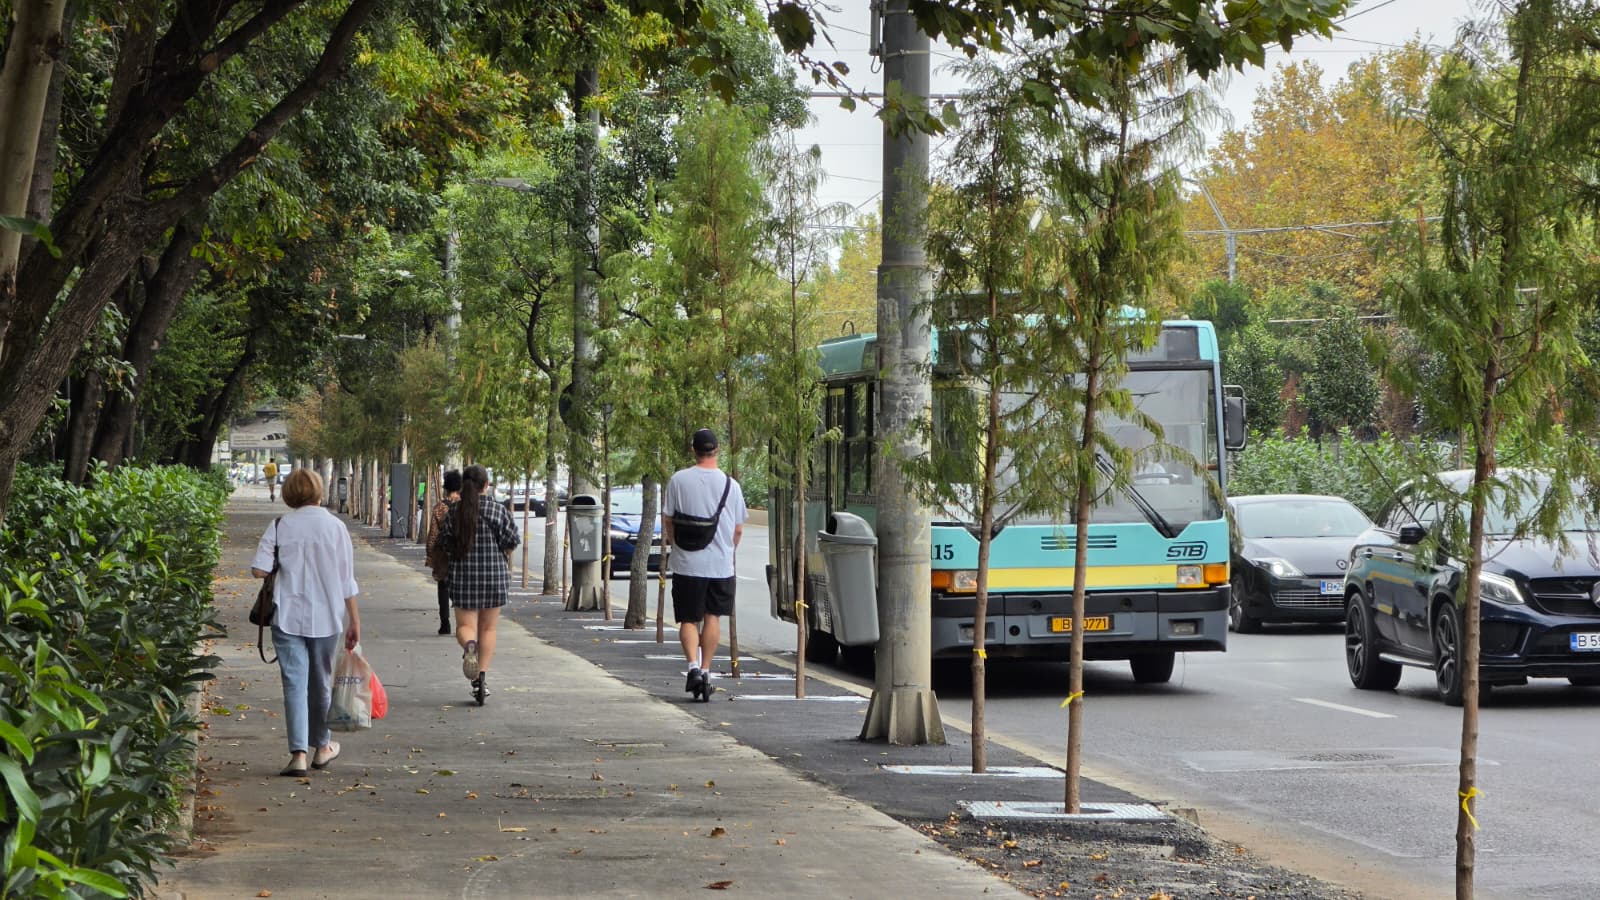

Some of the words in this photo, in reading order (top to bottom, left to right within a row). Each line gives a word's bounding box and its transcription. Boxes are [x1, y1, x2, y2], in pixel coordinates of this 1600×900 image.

[931, 544, 954, 560] 15
[1166, 544, 1205, 558] STB
[1062, 619, 1070, 629] B
[1578, 635, 1587, 647] B
